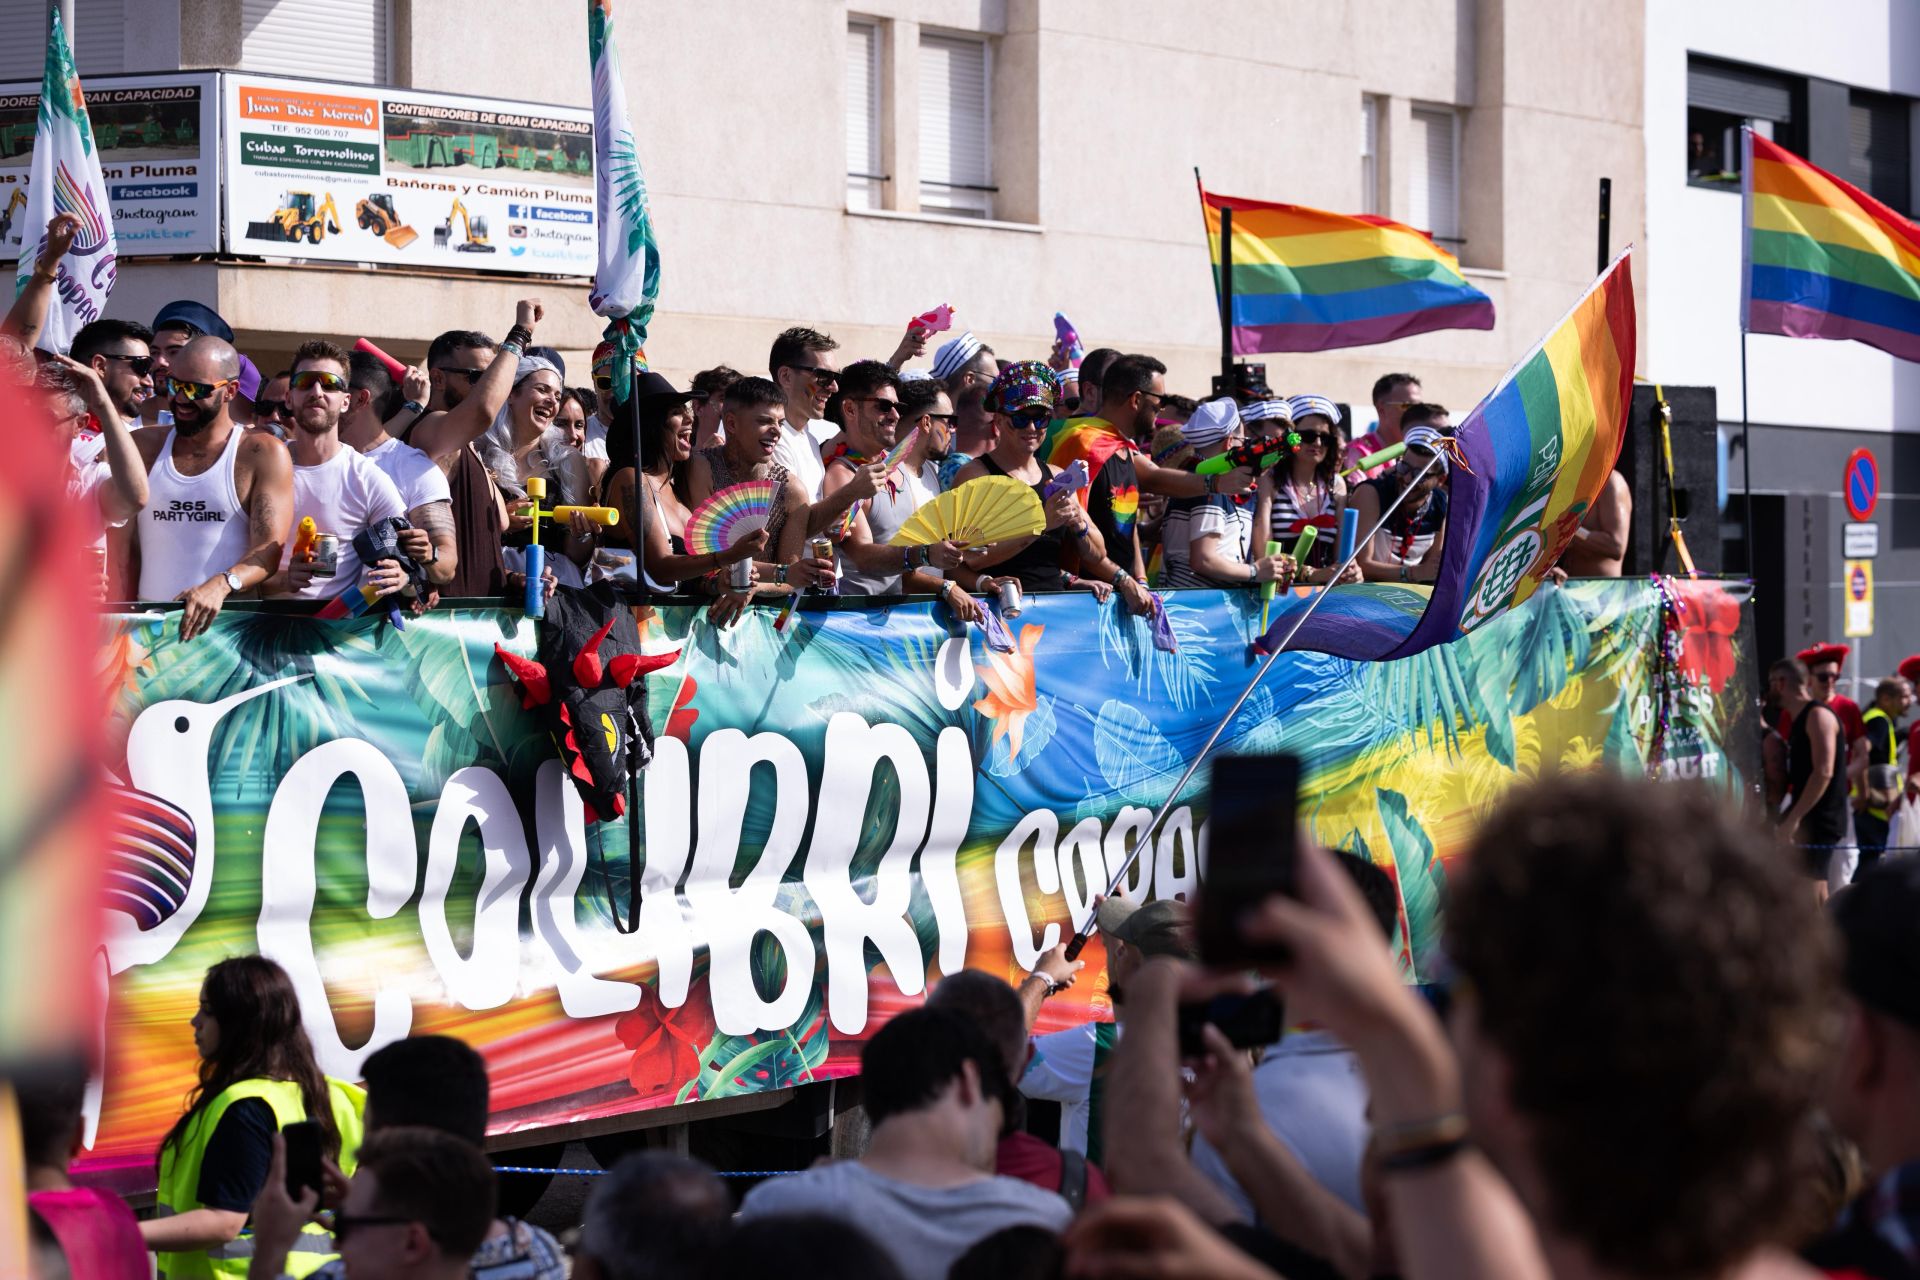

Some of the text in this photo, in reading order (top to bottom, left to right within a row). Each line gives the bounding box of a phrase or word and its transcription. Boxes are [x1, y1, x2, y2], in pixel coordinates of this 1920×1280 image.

[84, 88, 195, 103] RAN CAPACIDAD
[246, 96, 279, 115] Juan
[387, 103, 590, 134] CONTENEDORES DE GRAN CAPACIDAD
[295, 127, 312, 136] 952
[313, 128, 331, 137] 006
[333, 129, 349, 138] 707
[246, 141, 375, 162] Cubas Torremolinos
[130, 165, 197, 178] Pluma
[120, 186, 190, 198] facebook
[386, 177, 593, 204] Bañeras y Camión Pluma
[112, 207, 198, 224] Instagram
[536, 208, 589, 222] facebook
[114, 230, 196, 240] twitter
[531, 228, 593, 246] Instagram
[169, 500, 206, 511] 365
[153, 510, 226, 522] PARTYGIRL
[994, 806, 1212, 973] COPA
